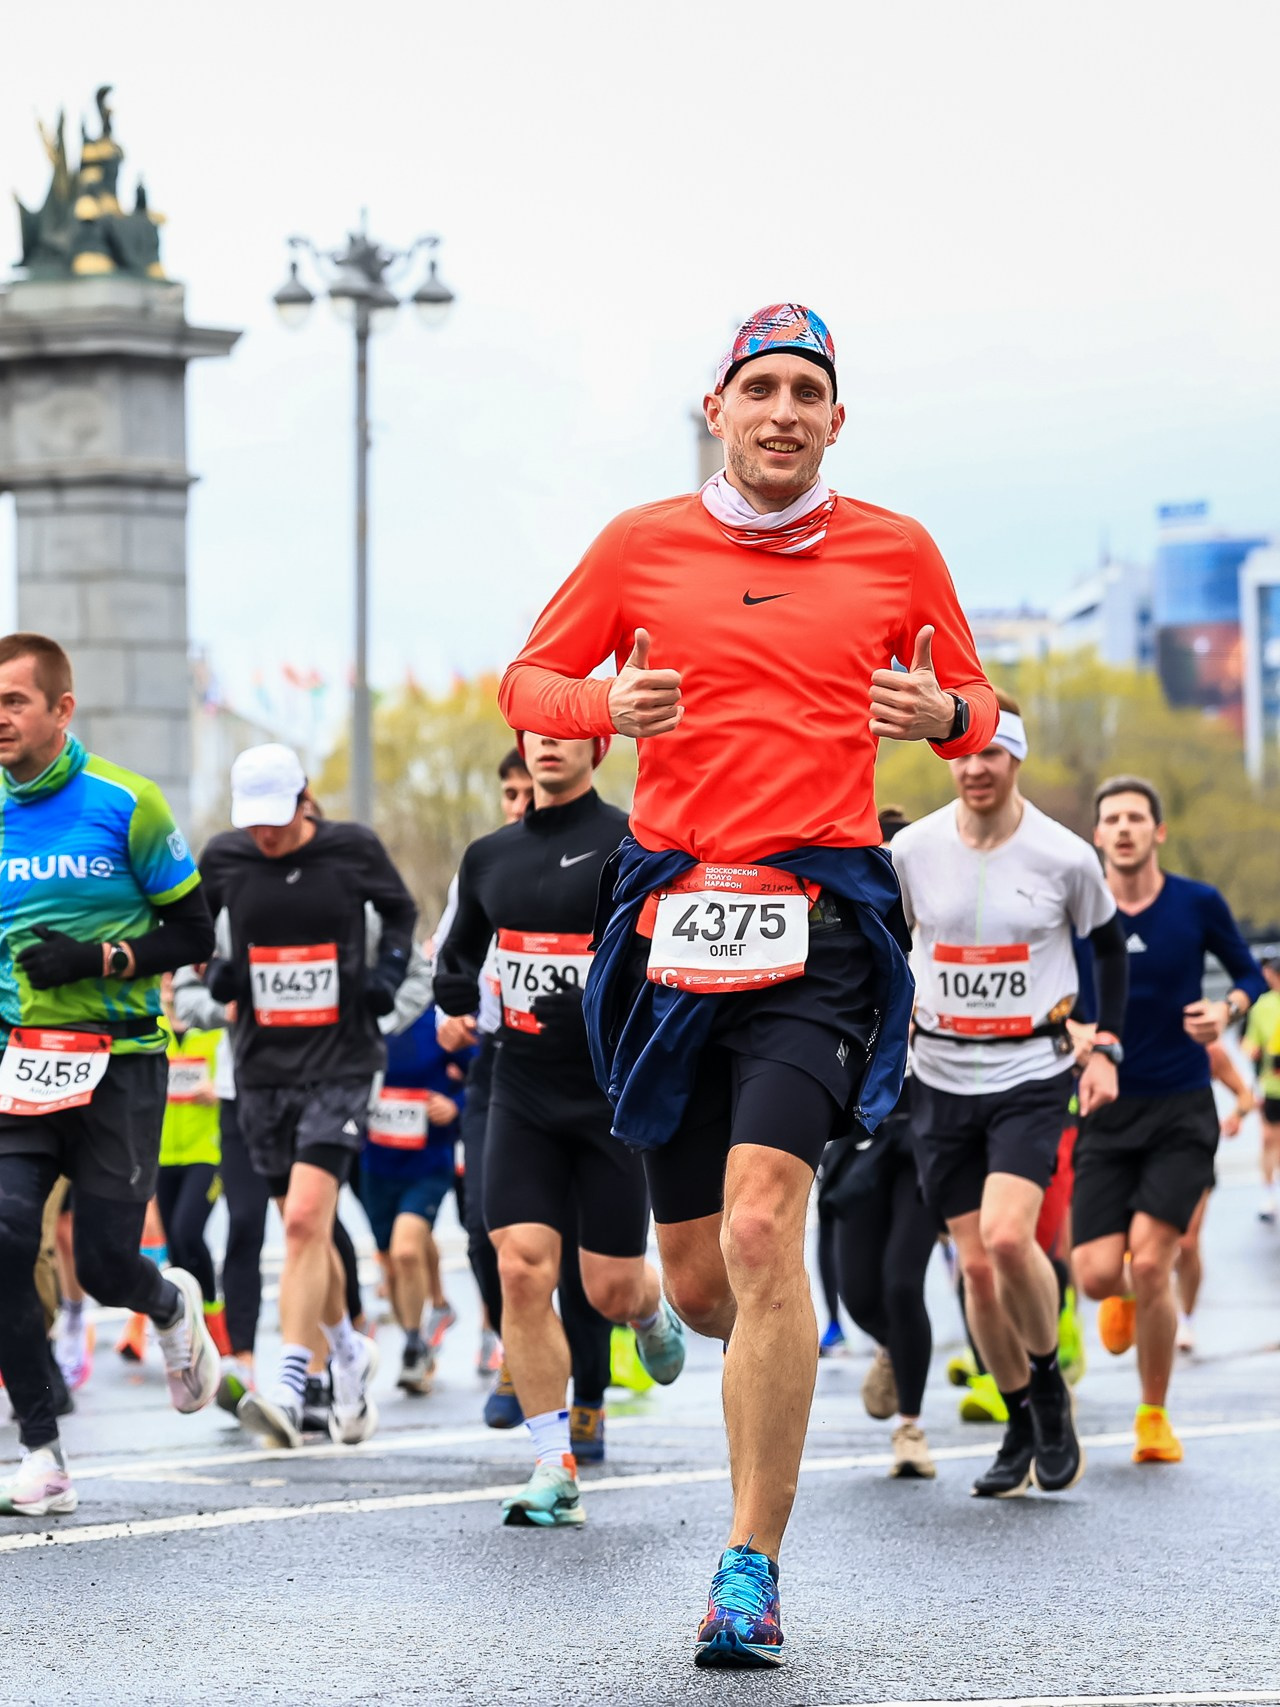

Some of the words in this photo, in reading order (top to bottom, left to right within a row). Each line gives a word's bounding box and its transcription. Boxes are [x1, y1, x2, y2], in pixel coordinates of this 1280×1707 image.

[706, 866, 758, 877] МОСКОВСКИЙ
[704, 881, 742, 889] МАРАФОН
[672, 902, 786, 942] 4375
[709, 944, 746, 957] ОЛЕГ
[256, 968, 333, 994] 16437
[938, 970, 1026, 999] 10478
[16, 1058, 91, 1087] 5458
